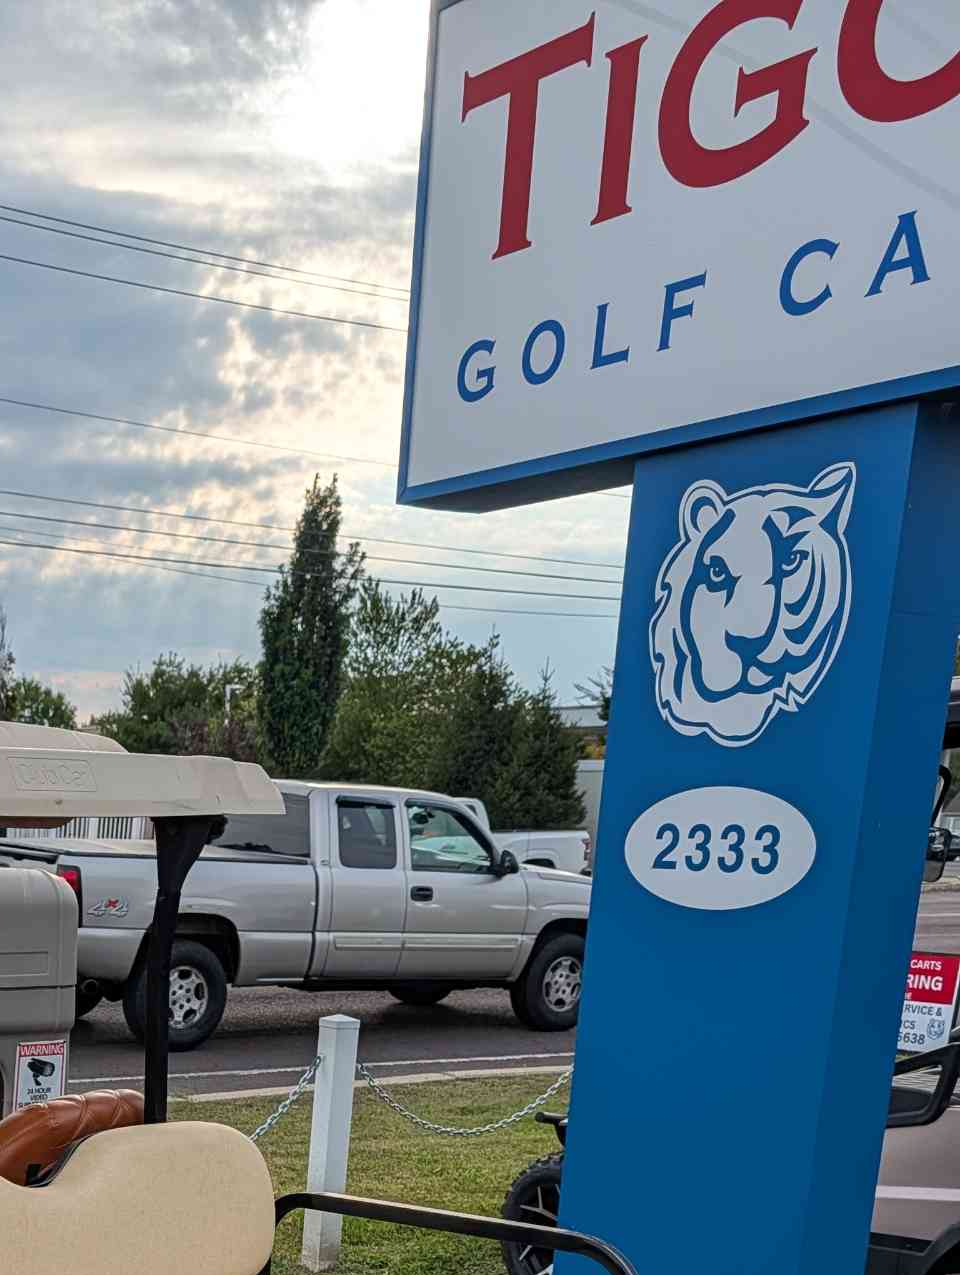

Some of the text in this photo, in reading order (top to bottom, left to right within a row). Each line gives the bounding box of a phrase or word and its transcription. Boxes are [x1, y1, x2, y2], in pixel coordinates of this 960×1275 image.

[457, 210, 930, 402] GOLF CA
[652, 823, 781, 875] 2333
[910, 959, 943, 971] CARTS
[20, 1044, 64, 1056] WARNING
